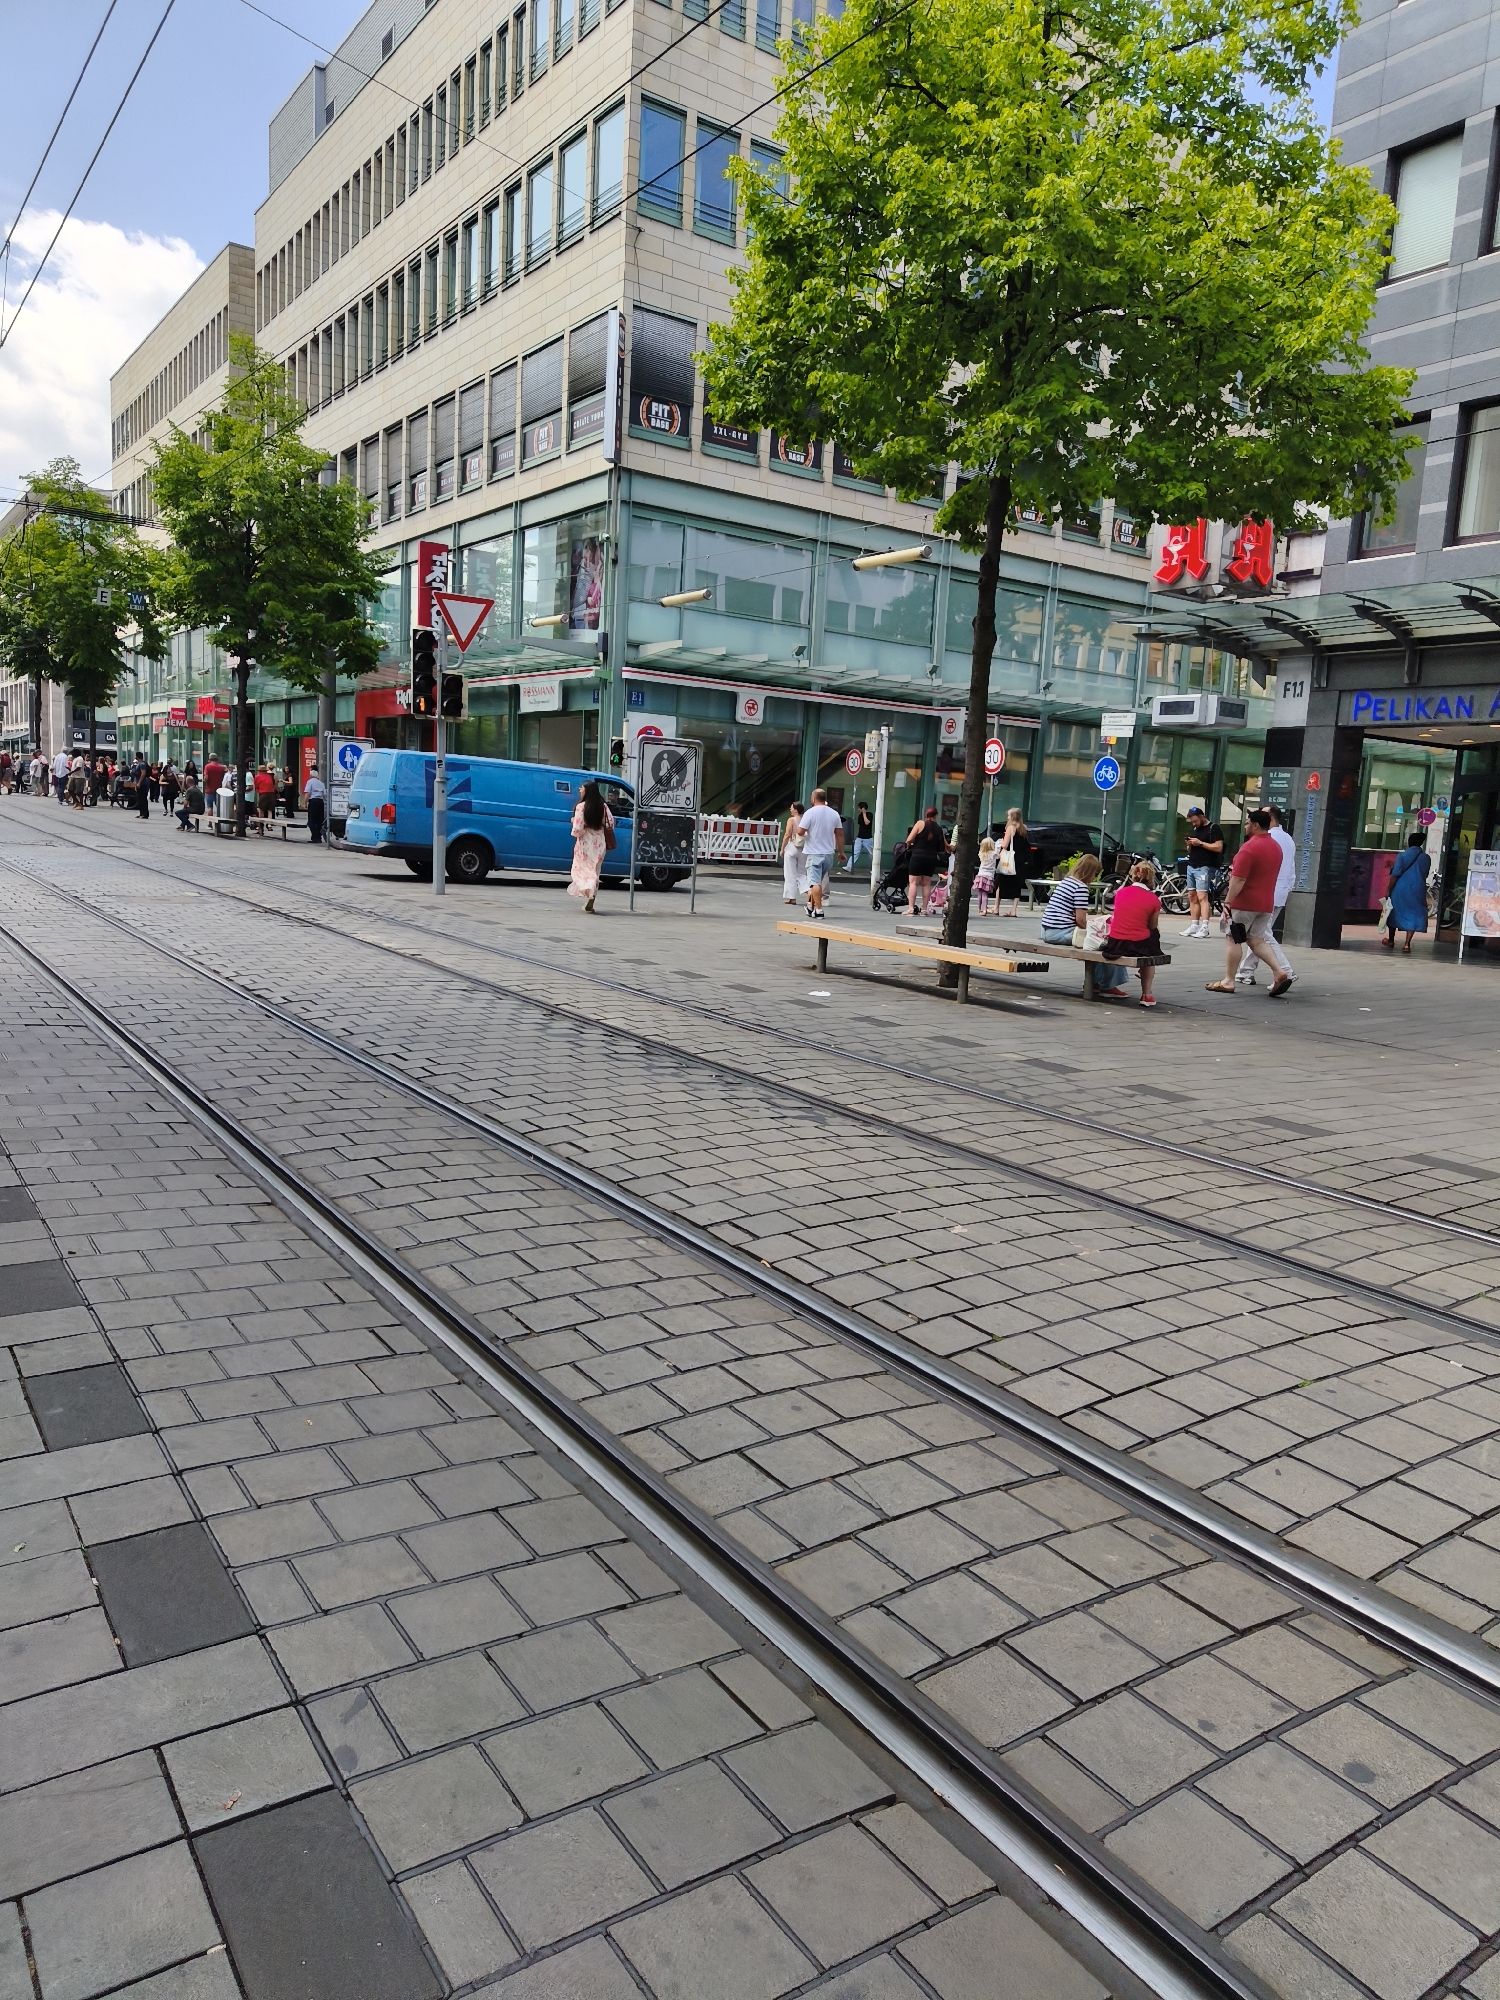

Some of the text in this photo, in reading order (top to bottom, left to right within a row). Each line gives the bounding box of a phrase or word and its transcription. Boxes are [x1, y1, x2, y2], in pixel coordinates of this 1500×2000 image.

[651, 402, 670, 418] FIT
[713, 425, 748, 441] XXL-GYM
[1121, 522, 1134, 534] FIT
[100, 590, 109, 604] E
[131, 594, 142, 605] W
[522, 686, 555, 698] ROSSMANN
[1353, 691, 1475, 721] PELIKAN
[165, 718, 188, 728] HEMA
[849, 754, 859, 769] 30
[986, 749, 999, 765] 30
